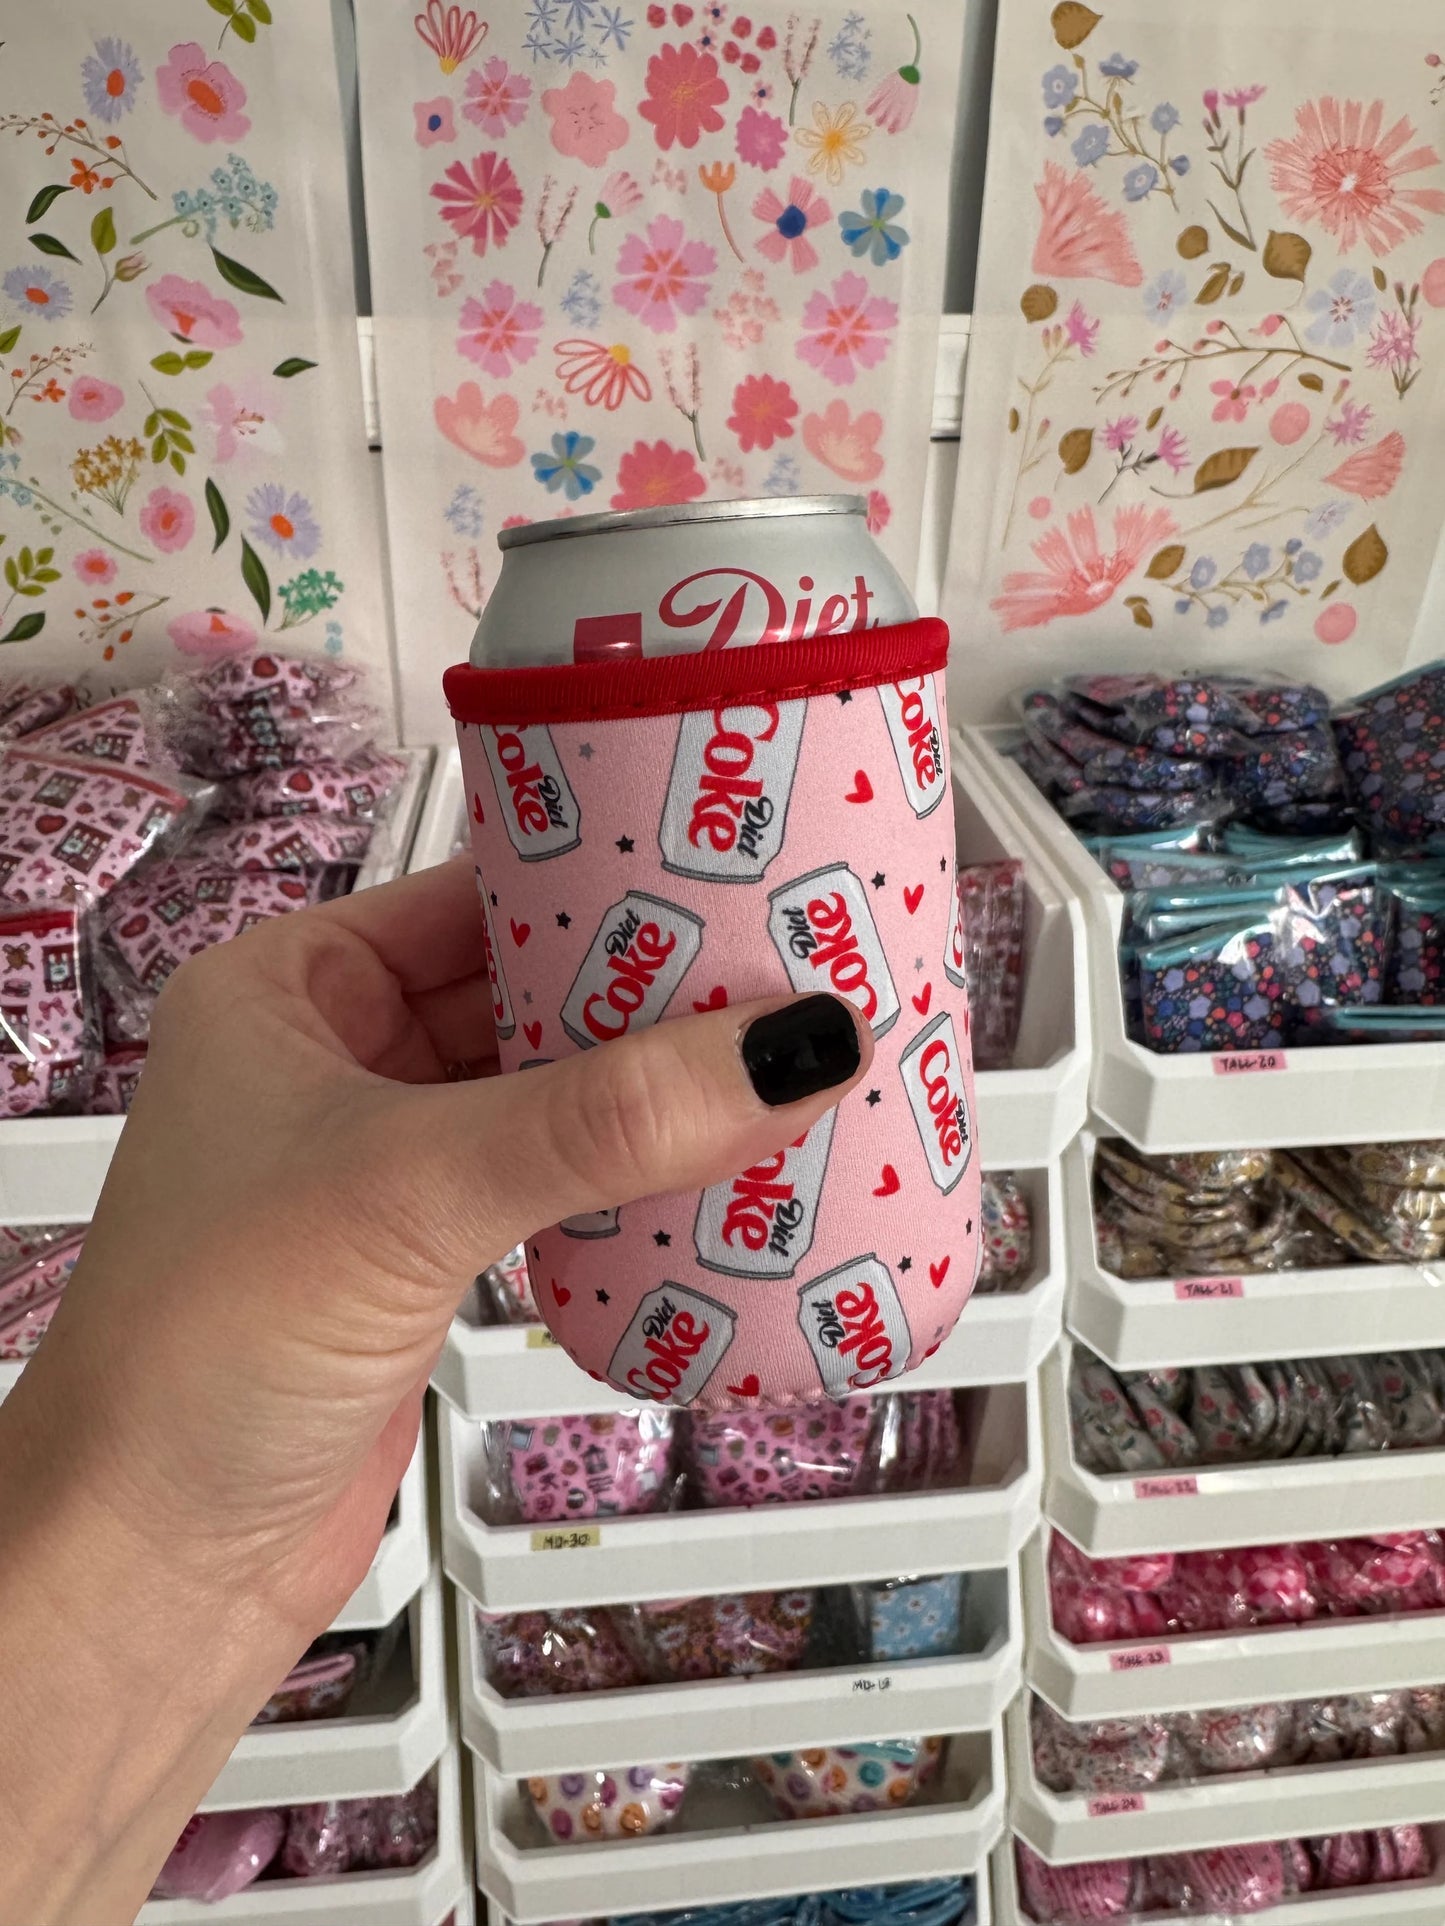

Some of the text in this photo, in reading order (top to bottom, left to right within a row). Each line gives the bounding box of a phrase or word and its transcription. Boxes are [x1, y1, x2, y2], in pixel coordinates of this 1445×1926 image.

[658, 567, 879, 651] Diet
[492, 724, 549, 836] oke
[537, 775, 569, 830] Diet
[737, 795, 774, 860] Diet
[604, 908, 641, 957] Diet
[782, 906, 818, 959] Diet
[582, 922, 677, 1041] Coke
[919, 1039, 961, 1167] Coke
[768, 1198, 804, 1257] Diet
[642, 1295, 677, 1340] Diet
[811, 1299, 846, 1348] Diet
[626, 1311, 710, 1401] Coke
